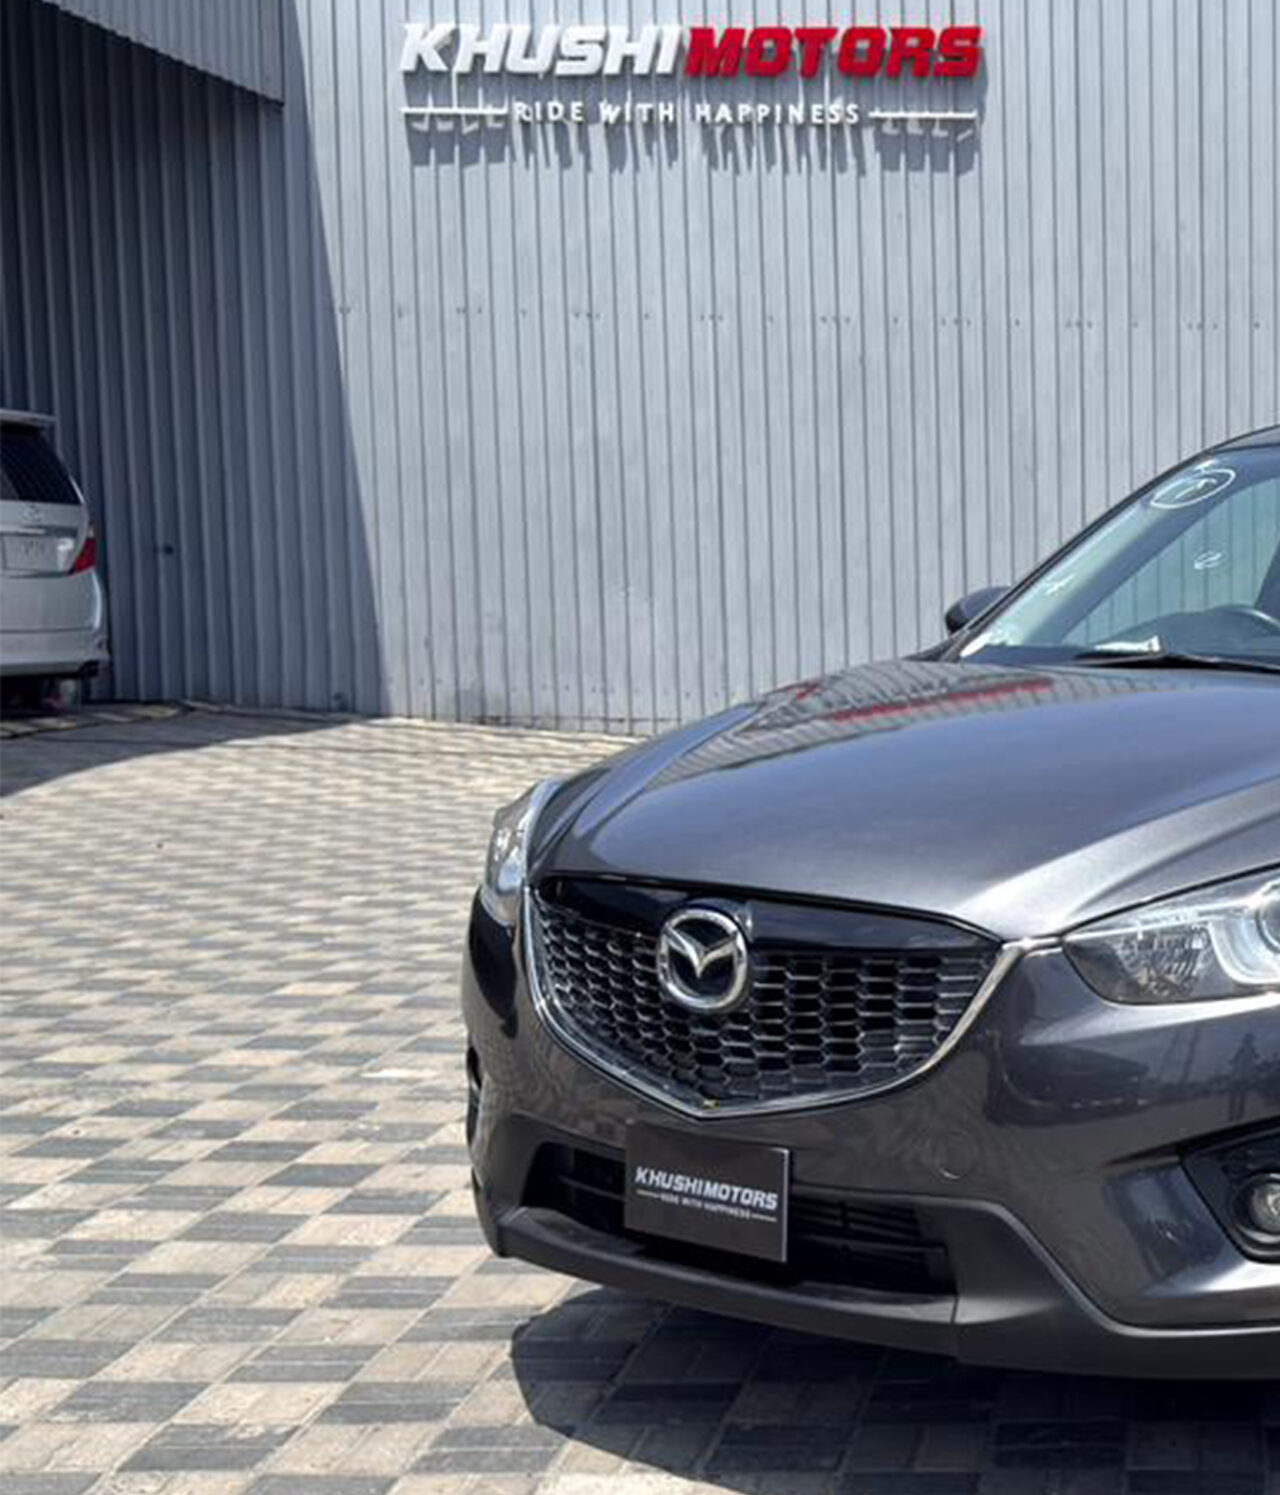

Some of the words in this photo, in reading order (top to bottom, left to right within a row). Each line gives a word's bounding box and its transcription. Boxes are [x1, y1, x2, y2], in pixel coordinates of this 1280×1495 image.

[514, 101, 584, 123] RIDE
[599, 101, 676, 124] WITH
[694, 102, 860, 125] HAPPINESS
